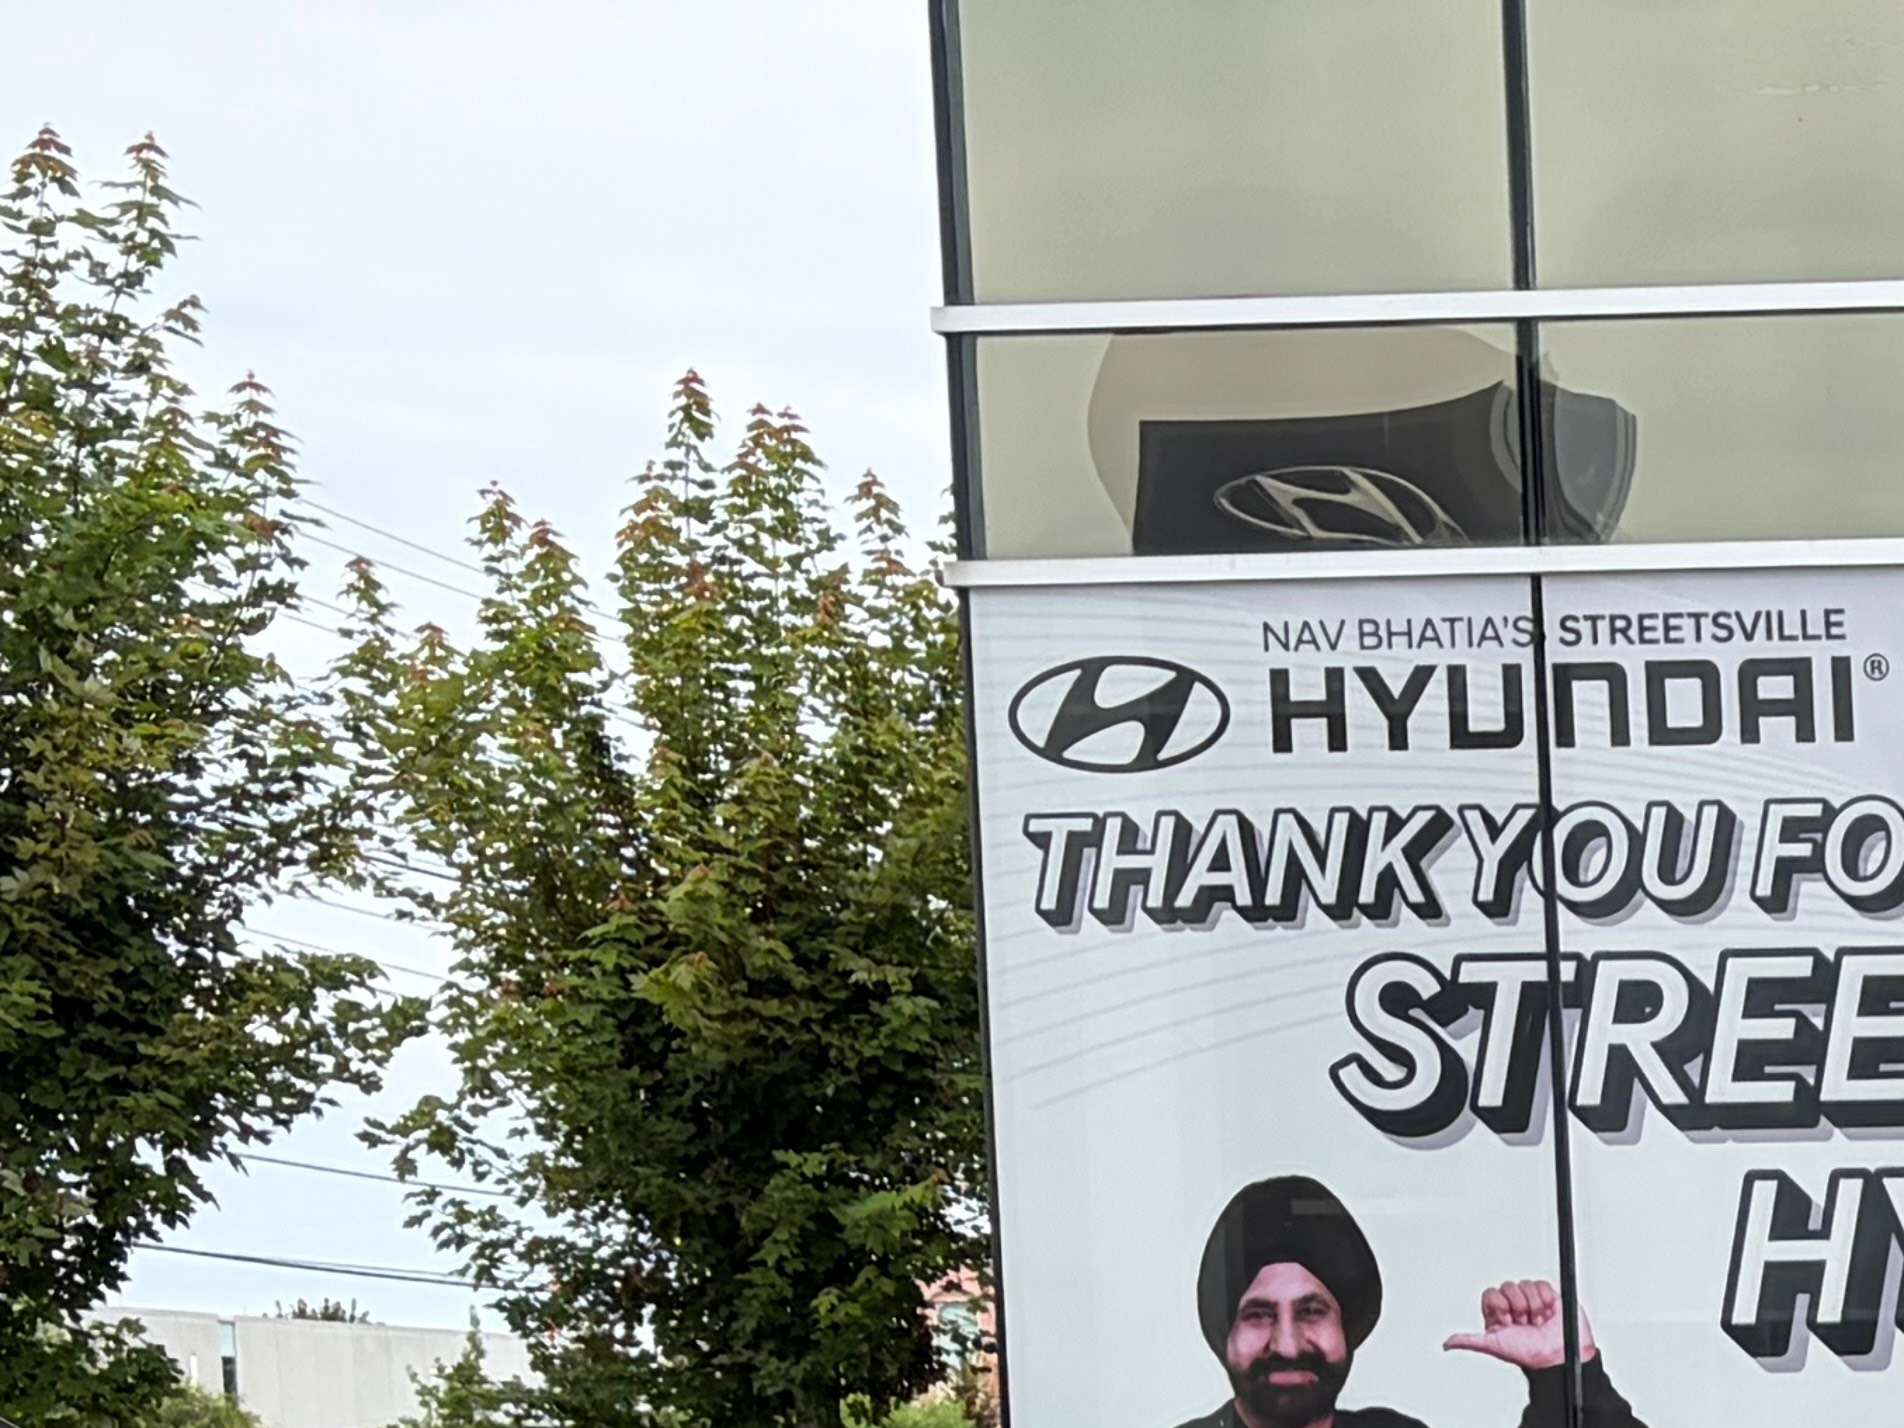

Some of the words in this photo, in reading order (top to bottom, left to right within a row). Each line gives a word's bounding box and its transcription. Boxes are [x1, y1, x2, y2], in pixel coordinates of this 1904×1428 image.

[1261, 619, 1347, 653] NAV
[1358, 615, 1535, 652] BHATIA'S
[1558, 608, 1847, 647] STREETSVILLE
[1023, 805, 1455, 927] THANK
[1457, 800, 1735, 921] YOU
